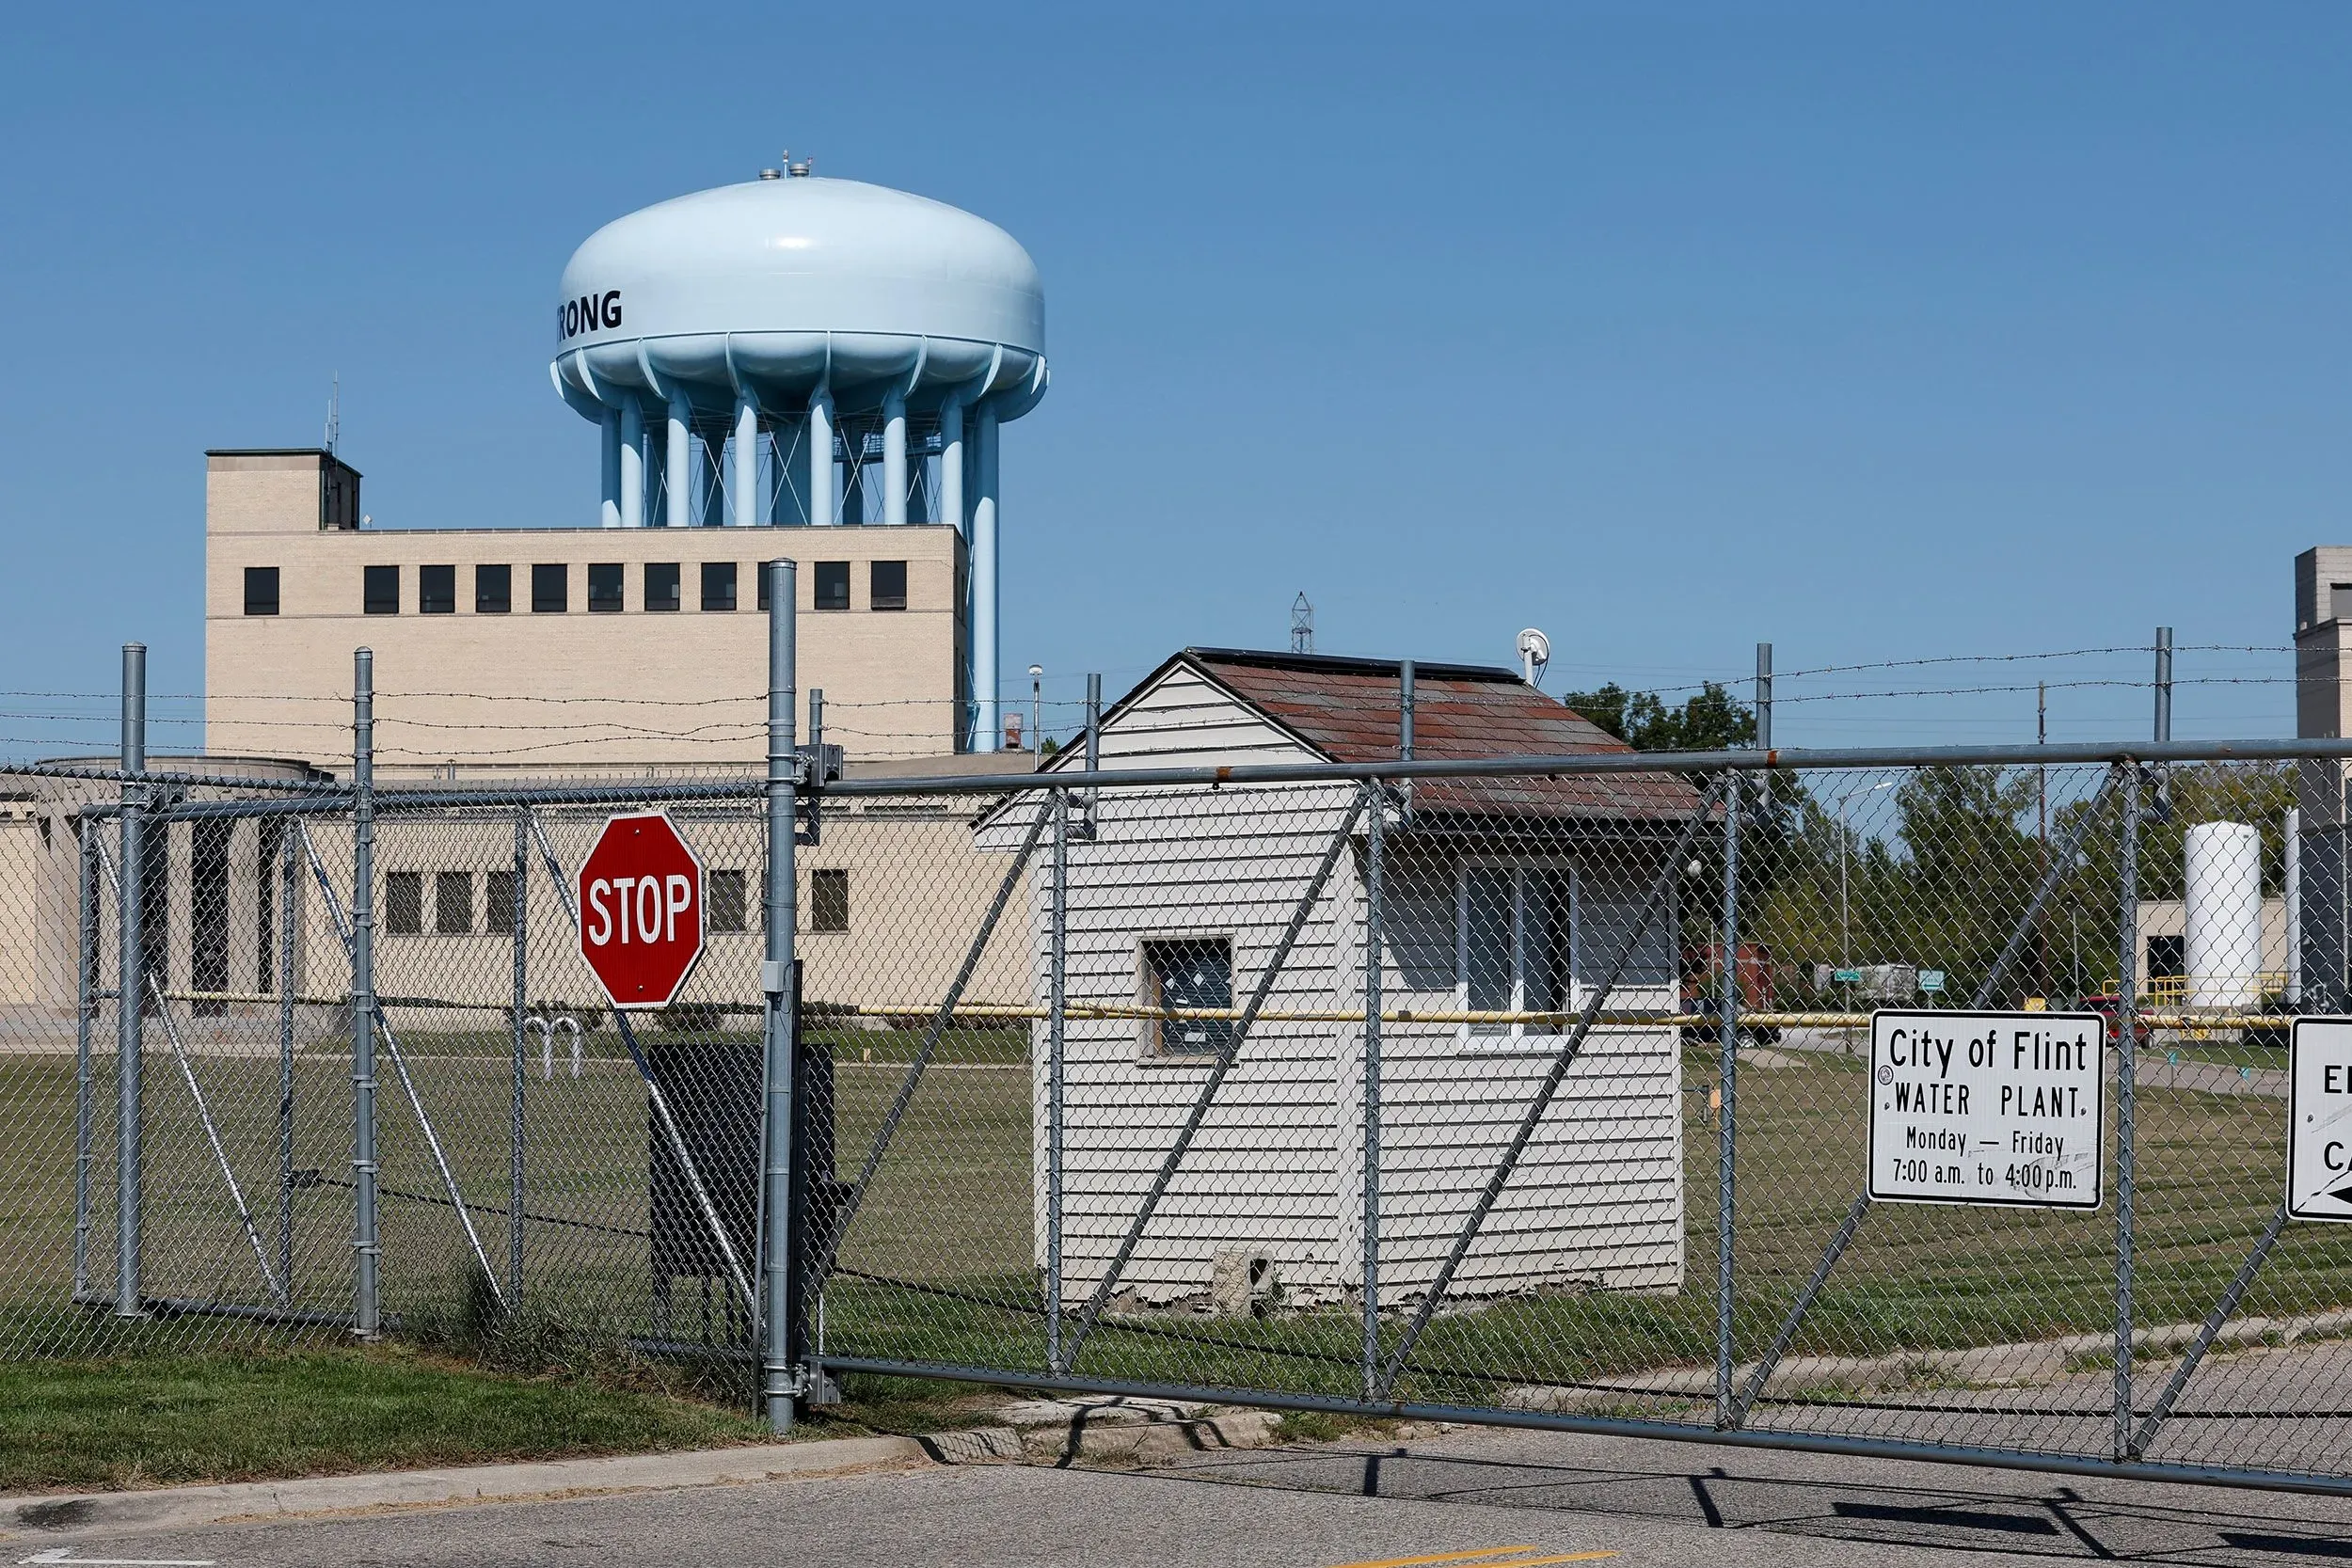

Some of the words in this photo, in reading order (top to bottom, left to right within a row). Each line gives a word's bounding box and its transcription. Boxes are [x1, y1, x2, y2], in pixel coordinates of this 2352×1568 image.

[588, 874, 691, 946] STOP
[1889, 1028, 1954, 1079] City
[1968, 1029, 1996, 1068] of
[2013, 1031, 2087, 1071] Flint
[1895, 1082, 1970, 1116] WATER
[2000, 1085, 2079, 1118] PLANT
[1906, 1126, 1966, 1158] Monday
[2012, 1130, 2064, 1162] Friday
[1893, 1158, 1928, 1183] 7:00
[1934, 1164, 1965, 1184] a.m.
[1978, 1163, 1994, 1186] to
[2005, 1163, 2042, 1189] 4:00
[2045, 1167, 2077, 1194] p.m.
